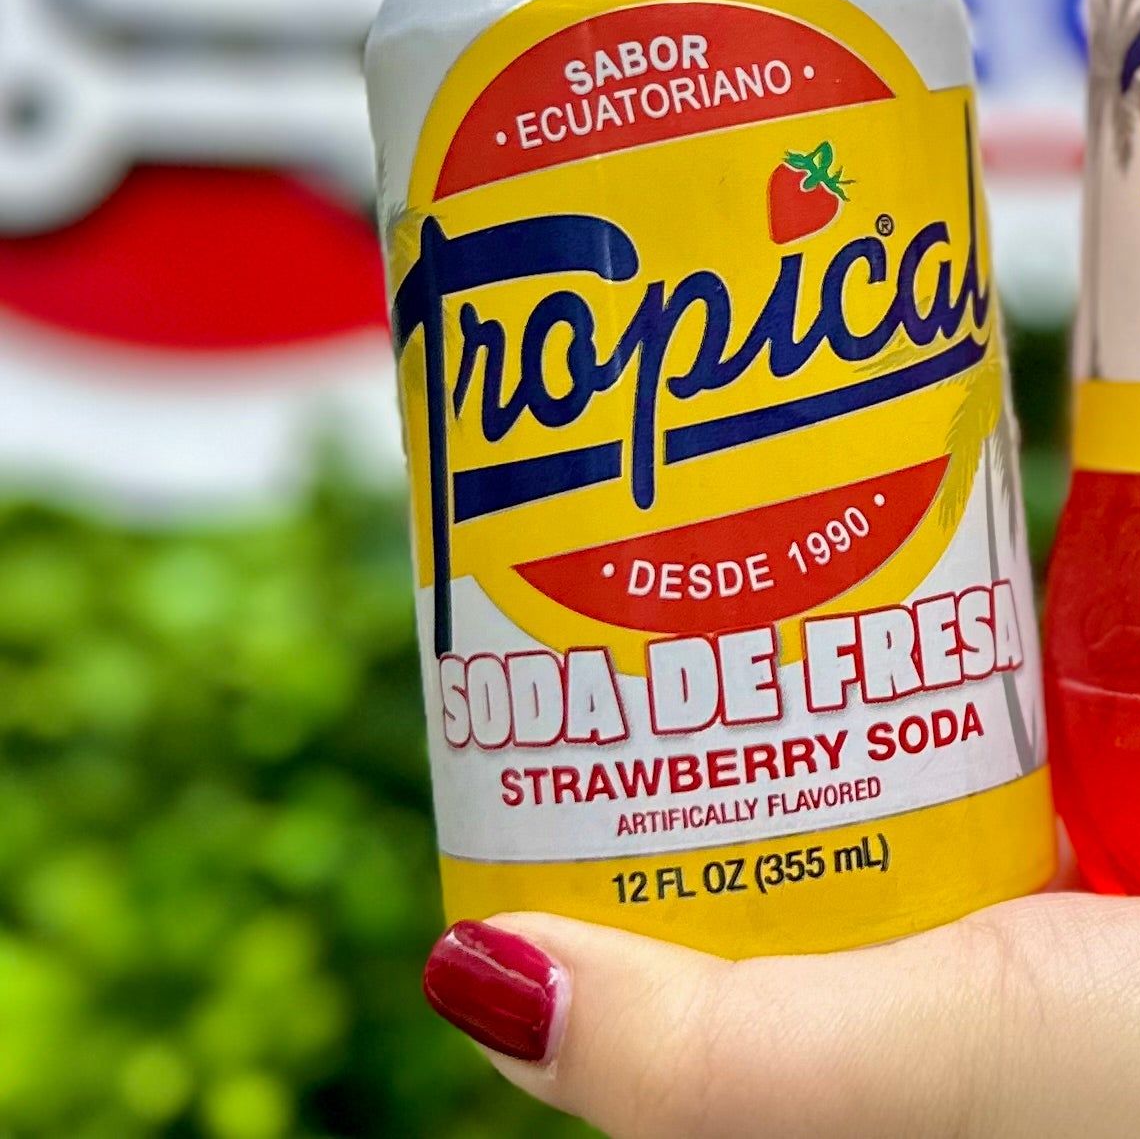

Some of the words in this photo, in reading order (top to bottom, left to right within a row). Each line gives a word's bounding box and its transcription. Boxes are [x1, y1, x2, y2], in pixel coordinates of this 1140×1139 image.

[515, 59, 793, 150] ECUATORIANO
[563, 33, 710, 96] SABOR
[391, 98, 992, 658] Tropical
[628, 553, 774, 599] DESDE
[788, 505, 869, 575] 1990
[438, 646, 630, 750] SODA
[646, 623, 784, 736] DE
[803, 579, 1024, 715] FRESA
[500, 729, 848, 807] STRAWBERRY
[867, 701, 986, 762] SODA
[616, 796, 759, 837] ARTIFICALLY
[767, 775, 882, 815] FLAVORED
[611, 871, 649, 905] 12
[656, 867, 697, 901] FL
[703, 859, 746, 894] OZ
[754, 846, 823, 892] (355
[834, 833, 891, 874] mL)
